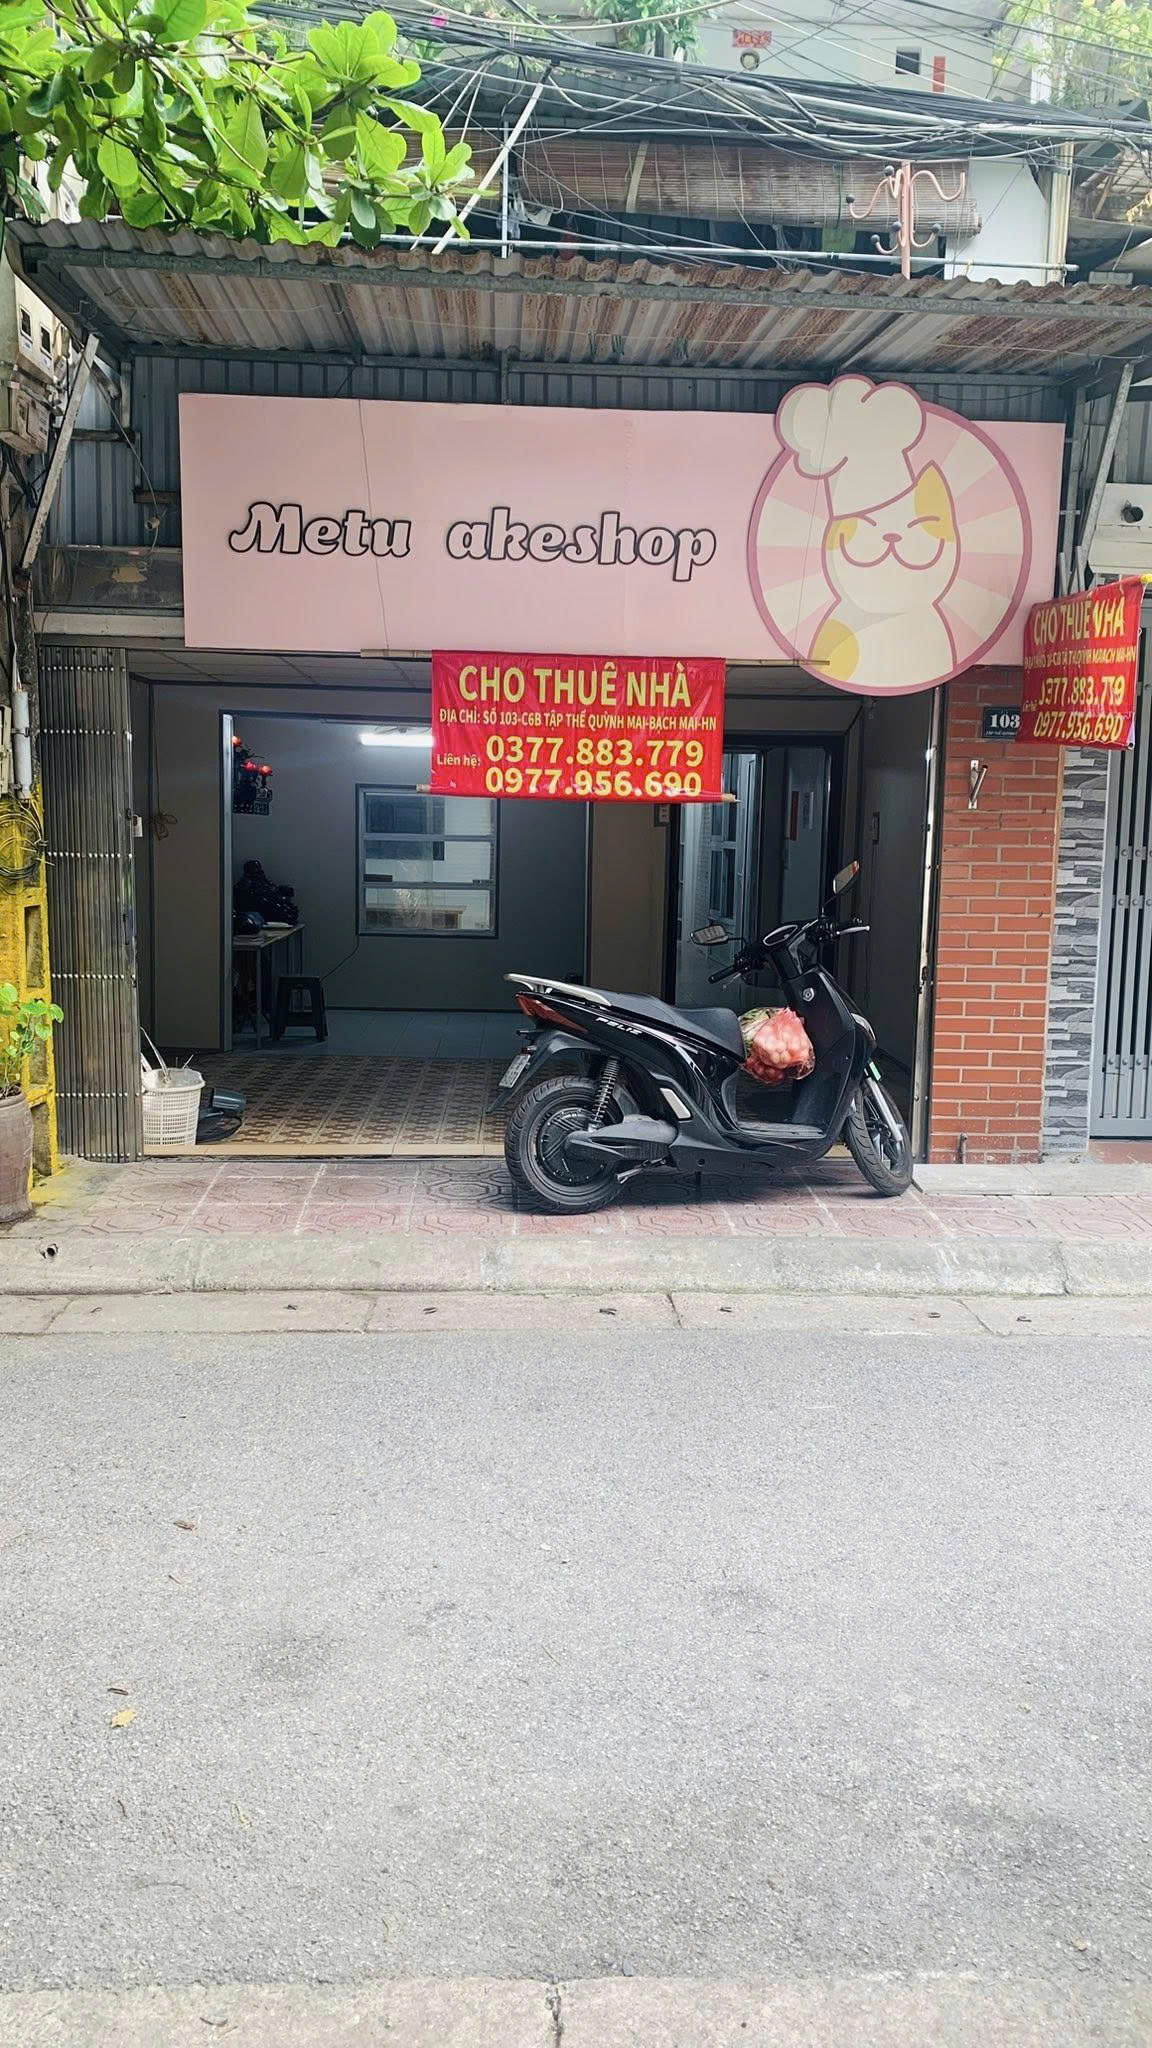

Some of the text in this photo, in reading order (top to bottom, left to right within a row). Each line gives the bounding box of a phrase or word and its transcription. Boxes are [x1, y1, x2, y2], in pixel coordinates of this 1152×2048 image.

[228, 501, 717, 582] Metu akeshop
[1034, 607, 1058, 646] CHO
[459, 661, 692, 708] CHO THUÊ NHÀ
[439, 708, 457, 727] ĐỊA
[459, 706, 480, 724] CHỈ:
[483, 706, 497, 725] SỐ
[500, 711, 541, 727] 103-C6B
[544, 709, 563, 731] TẬP
[588, 711, 624, 731] QUỲNH
[627, 714, 677, 734] MAI-BẠCH
[679, 716, 717, 731] MAI-HN
[990, 714, 1020, 728] 103
[1033, 711, 1124, 741] 0977.956.690
[437, 753, 480, 768] Liên hệ:
[486, 735, 704, 767] 0377.883.779
[485, 766, 702, 797] 0977.956.690
